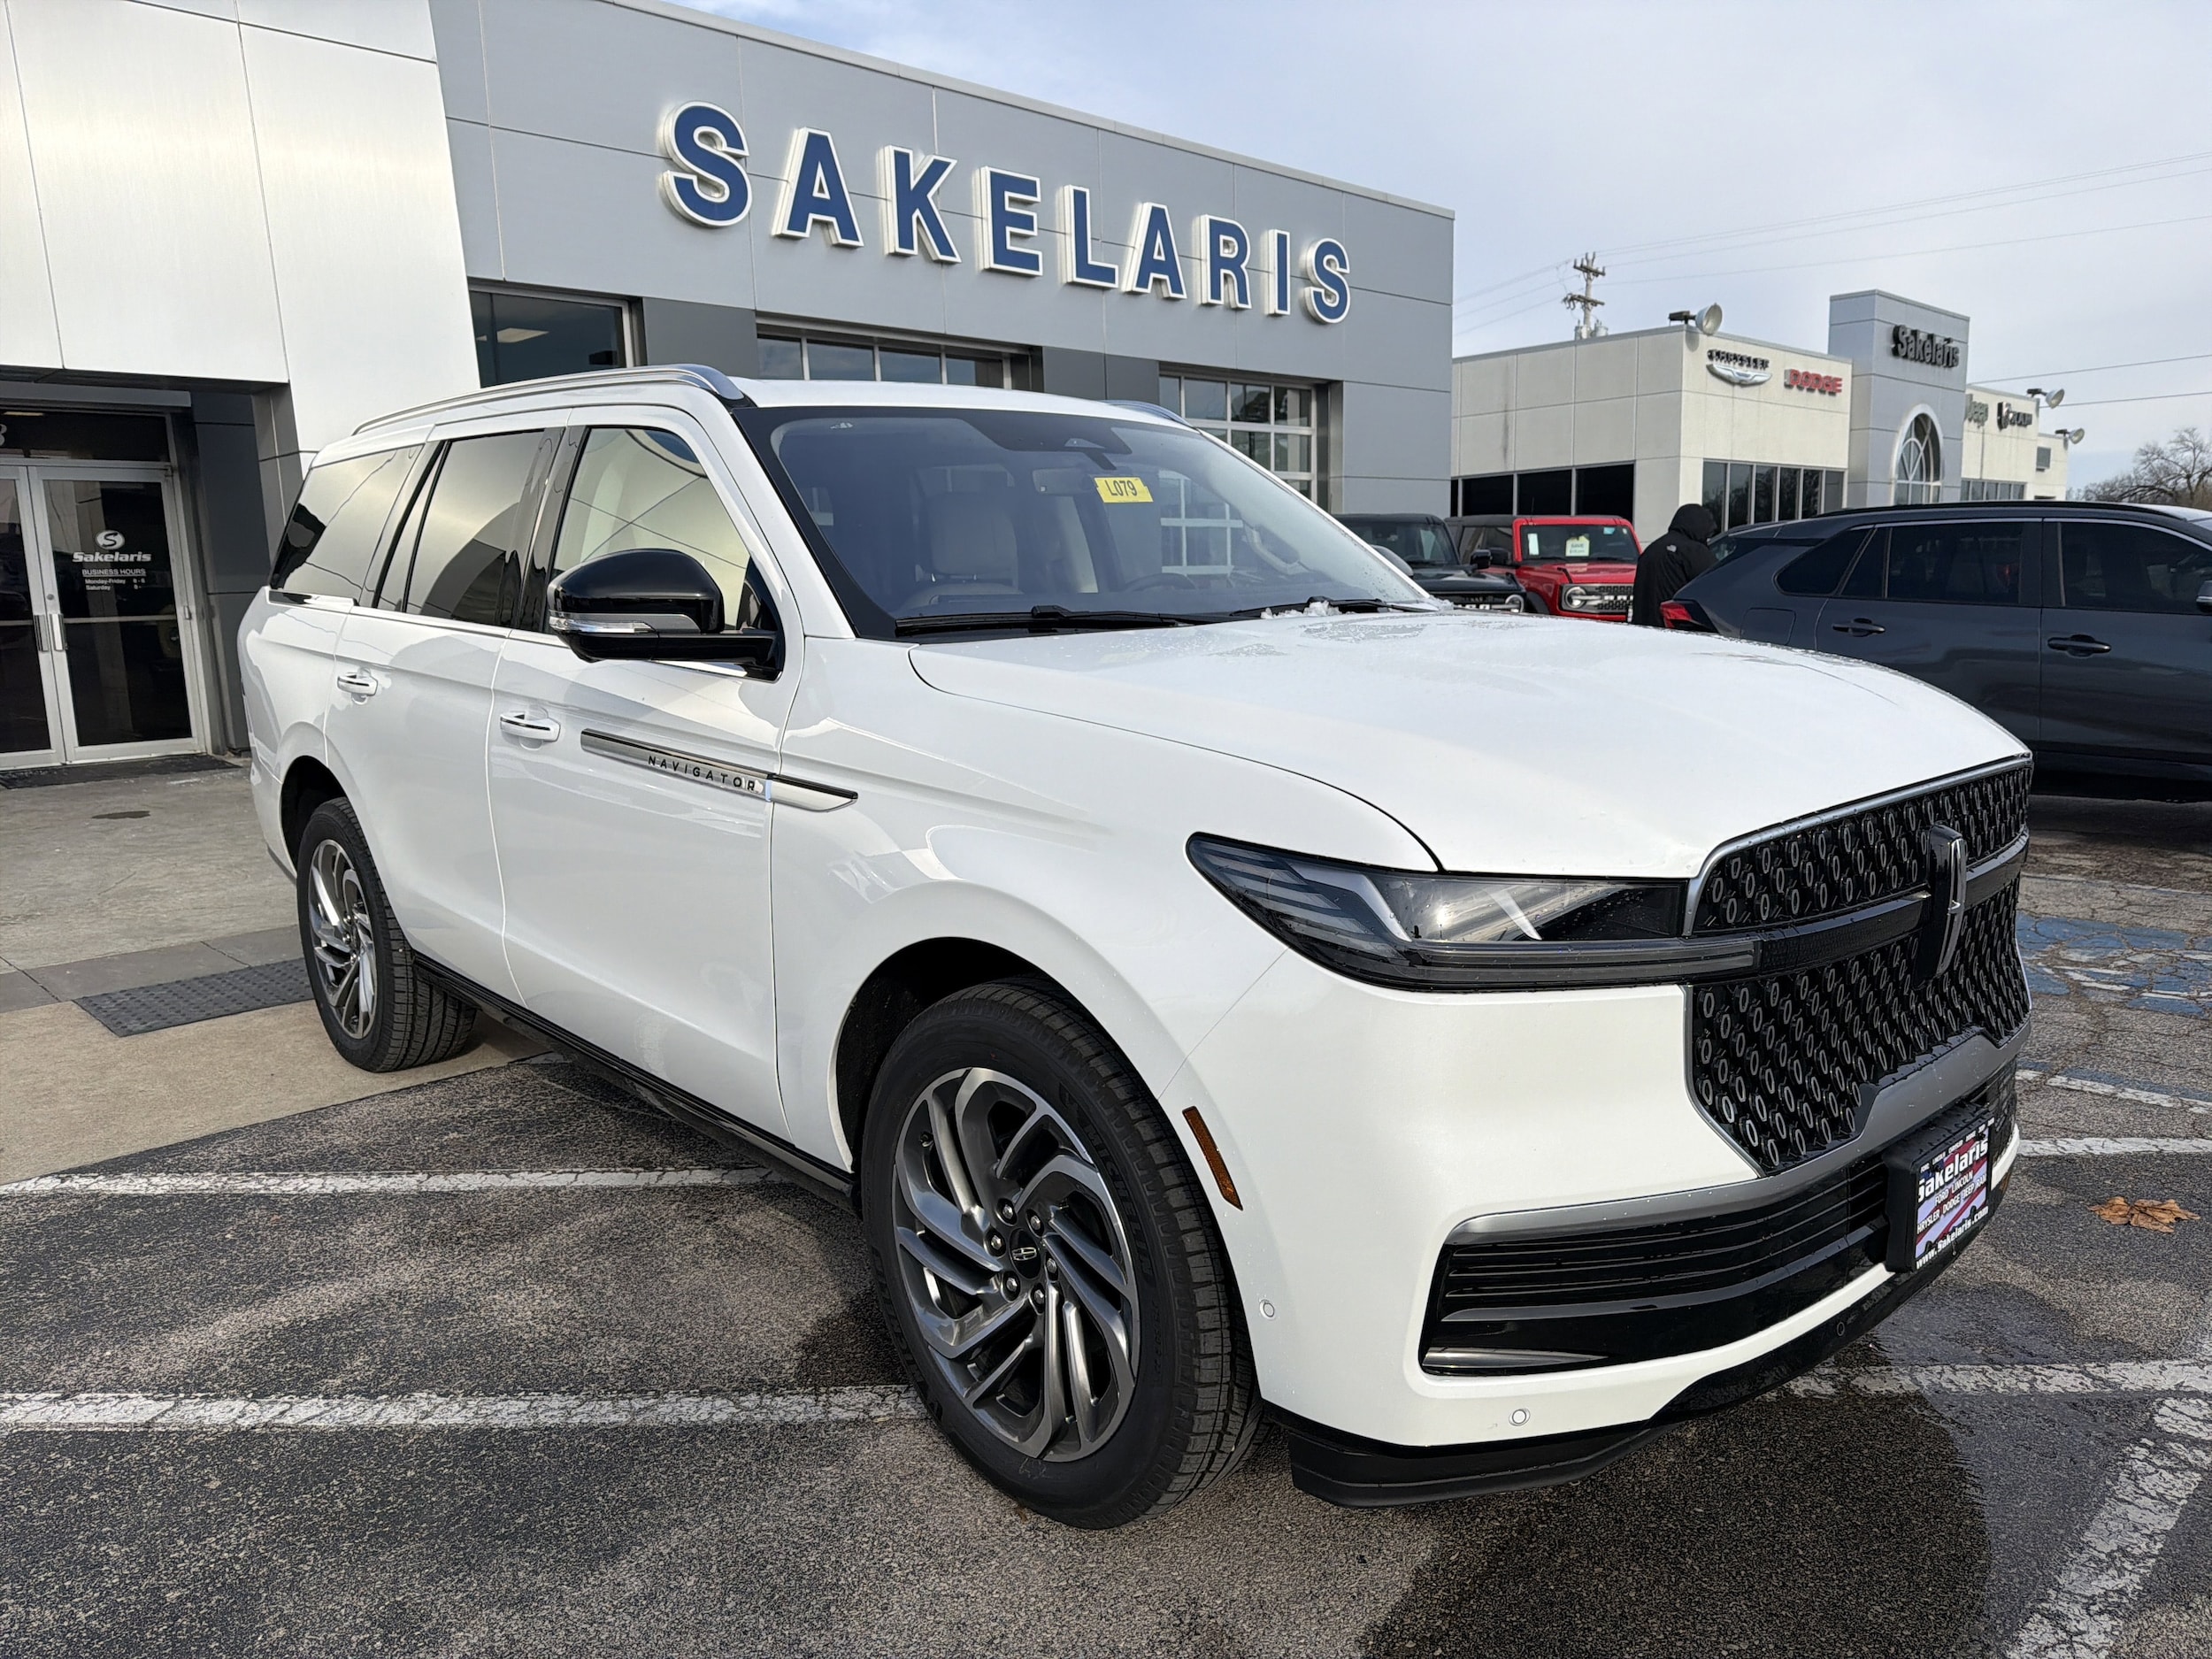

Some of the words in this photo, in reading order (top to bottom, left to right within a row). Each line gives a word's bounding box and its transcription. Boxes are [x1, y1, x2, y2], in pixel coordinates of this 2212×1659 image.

[660, 100, 1351, 326] SAKELARIS
[1893, 324, 1959, 368] Sakelaris
[1786, 369, 1843, 395] DODGE
[1104, 480, 1138, 496] L079
[72, 551, 152, 563] Sakelaris
[648, 755, 756, 792] NAVIGATOR
[1083, 1123, 1152, 1276] MICHELIN
[1935, 1188, 1948, 1205] FORD
[1951, 1170, 1973, 1194] LINCOLN
[1916, 1210, 1940, 1234] HRYSLER
[1942, 1194, 1961, 1214] DODGE
[1962, 1183, 1975, 1200] JEEP
[1916, 1205, 1989, 1270] www.Sakelaris.com
